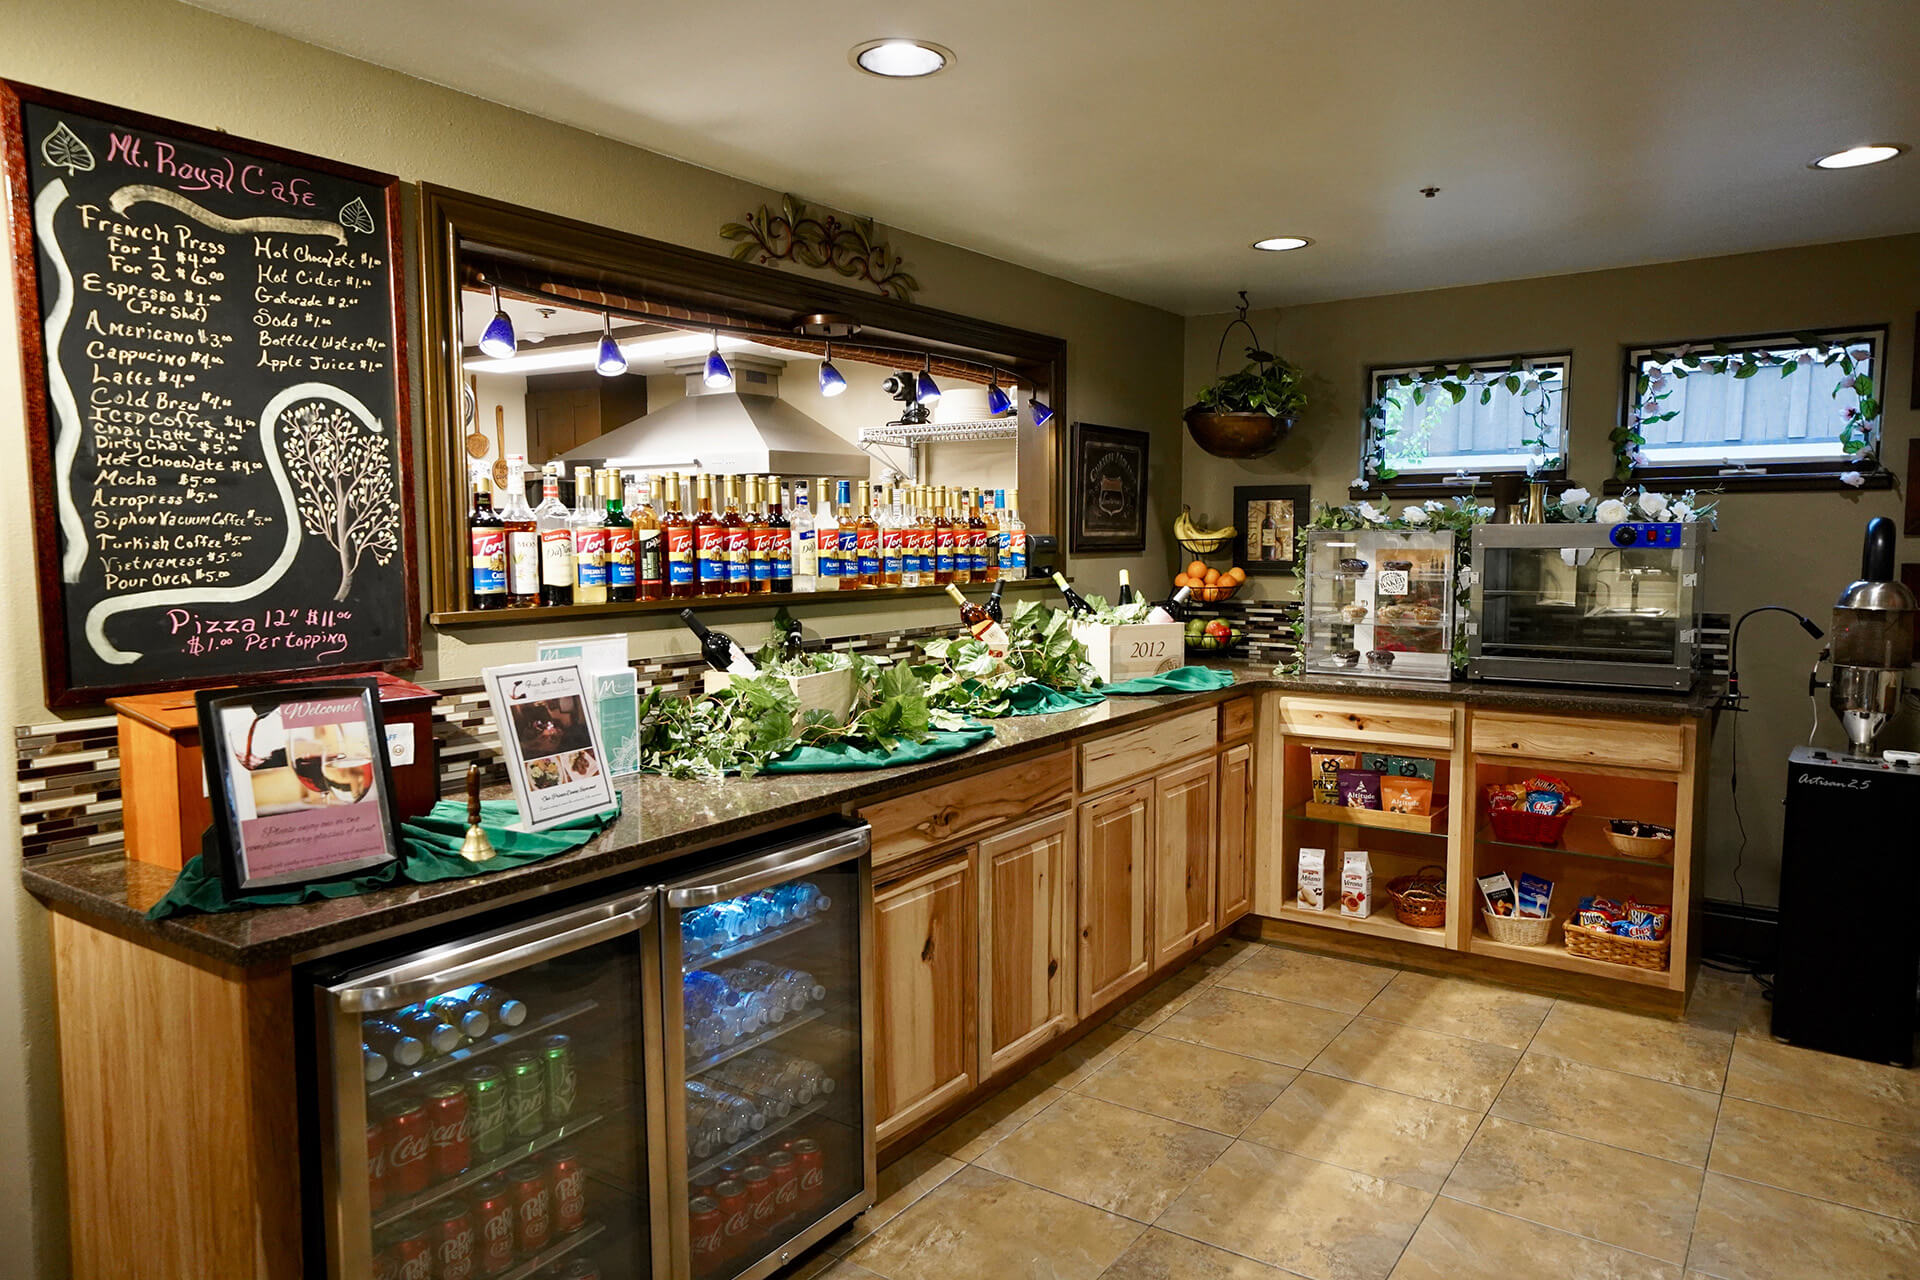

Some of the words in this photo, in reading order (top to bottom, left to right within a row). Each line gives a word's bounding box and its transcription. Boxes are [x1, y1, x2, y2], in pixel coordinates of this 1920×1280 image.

[106, 131, 149, 168] Mt.
[154, 140, 235, 194] Royal
[241, 164, 317, 206] Cafe
[75, 204, 169, 244] French
[174, 225, 226, 255] Press
[107, 236, 141, 254] For
[147, 245, 167, 261] 1
[254, 236, 289, 260] Hot
[293, 244, 355, 269] Chocolate
[108, 254, 143, 275] For
[151, 262, 172, 282] 2
[258, 264, 288, 284] Hot
[296, 270, 341, 287] Cider
[82, 273, 176, 301] Espresso
[254, 286, 323, 307] Gatorade
[126, 297, 167, 315] (Per
[170, 306, 207, 322] Shot)
[253, 308, 298, 327] Soda
[85, 309, 195, 345] Americano
[259, 330, 319, 350] Bottled
[321, 336, 364, 351] Water
[86, 340, 187, 367] Cappucino
[256, 349, 303, 372] Apple
[310, 356, 355, 371] Juice
[91, 363, 153, 385] Latte
[90, 387, 149, 409] Cold
[156, 392, 200, 411] Brew
[149, 411, 217, 431] Coffee
[93, 422, 143, 437] Chai
[150, 428, 198, 442] Latte
[95, 435, 143, 458] Dirty
[145, 439, 187, 451] Chai
[97, 453, 131, 467] Hot
[137, 455, 225, 471] Chocolate
[94, 470, 157, 486] Mocha
[91, 488, 183, 511] Aeropress
[93, 511, 156, 530] Siphon
[159, 510, 210, 526] Vacuum
[212, 512, 246, 527] Coffee
[96, 533, 170, 551] Turkish
[174, 535, 223, 550] Coffee
[100, 556, 204, 573] Vietnamese
[104, 573, 148, 591] Pour
[152, 573, 193, 586] Over
[166, 608, 256, 635] Pizza
[244, 633, 281, 651] Per
[285, 631, 348, 662] topping
[1129, 641, 1167, 659] 2012
[284, 700, 360, 720] Welcome!
[1798, 773, 1847, 789] Artisan
[1847, 777, 1872, 790] 2.5
[1347, 791, 1376, 800] Altitude
[1391, 799, 1420, 807] Altitude
[1533, 801, 1557, 812] Chex
[1629, 926, 1651, 937] Chex
